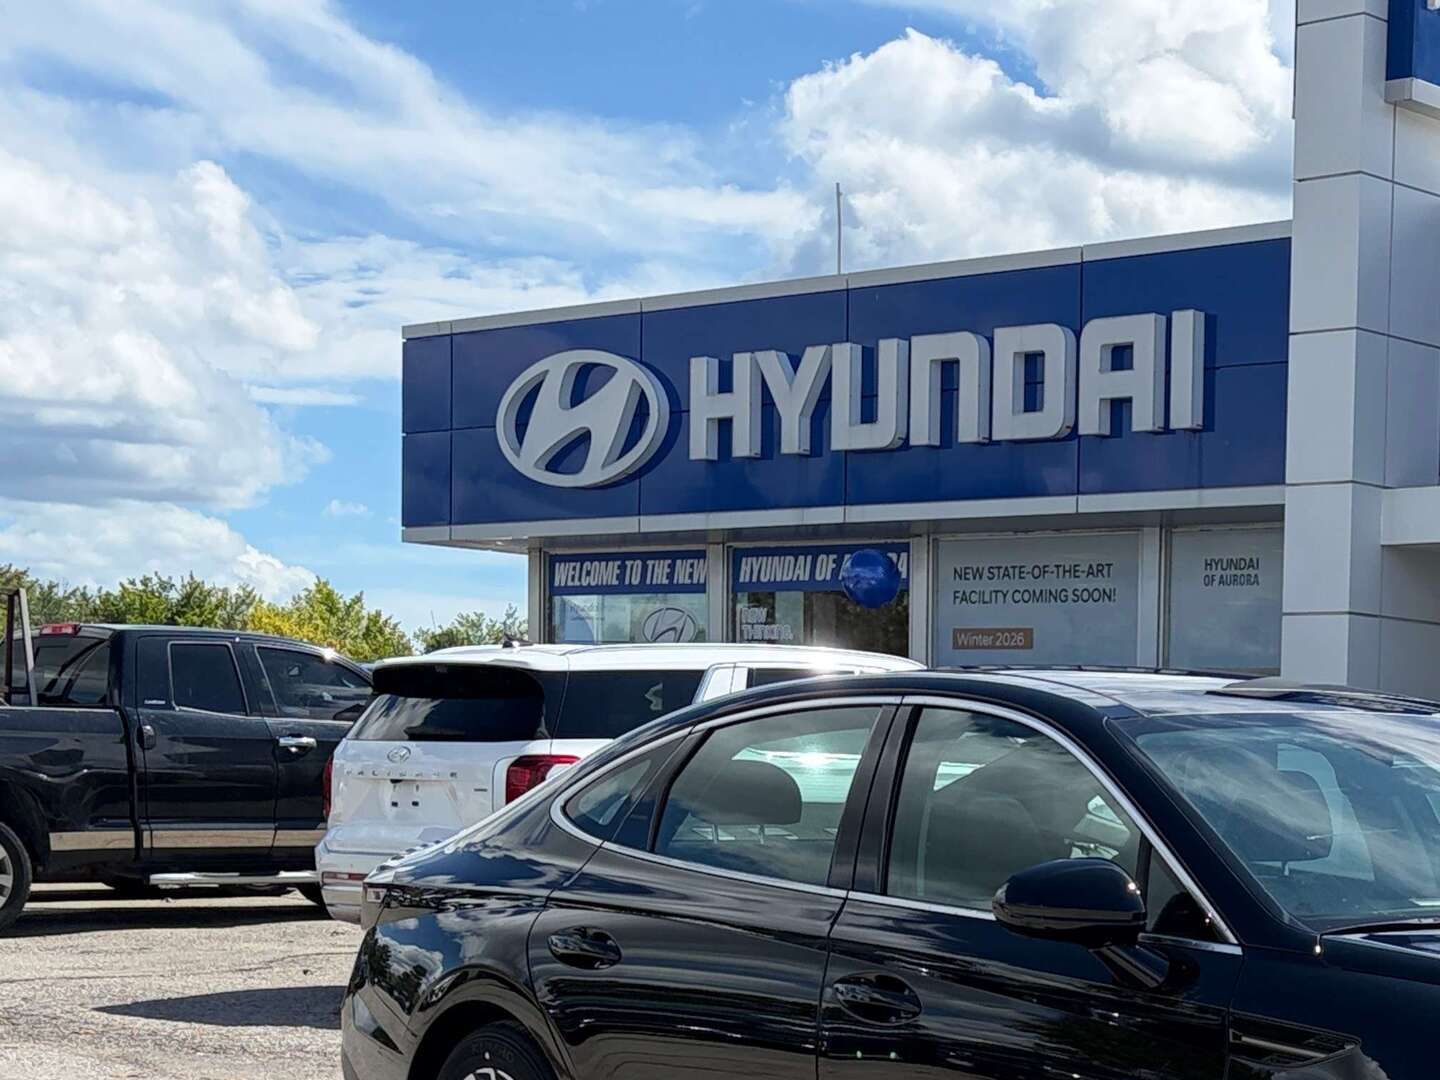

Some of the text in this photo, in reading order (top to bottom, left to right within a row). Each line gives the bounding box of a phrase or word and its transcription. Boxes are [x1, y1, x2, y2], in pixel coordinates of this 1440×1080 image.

[689, 308, 1206, 461] HYUNDAI
[554, 558, 707, 587] WELCOME TO THE NEW
[739, 555, 812, 583] HYUNDAI
[815, 553, 837, 582] OF
[953, 563, 1113, 581] NEW STATE-OF-THE-ART
[1204, 557, 1259, 571] HYUNDAI
[1203, 573, 1260, 587] OF AURORA
[953, 587, 1117, 605] FACILITY COMING SOON!
[956, 632, 1025, 646] Winter 2026
